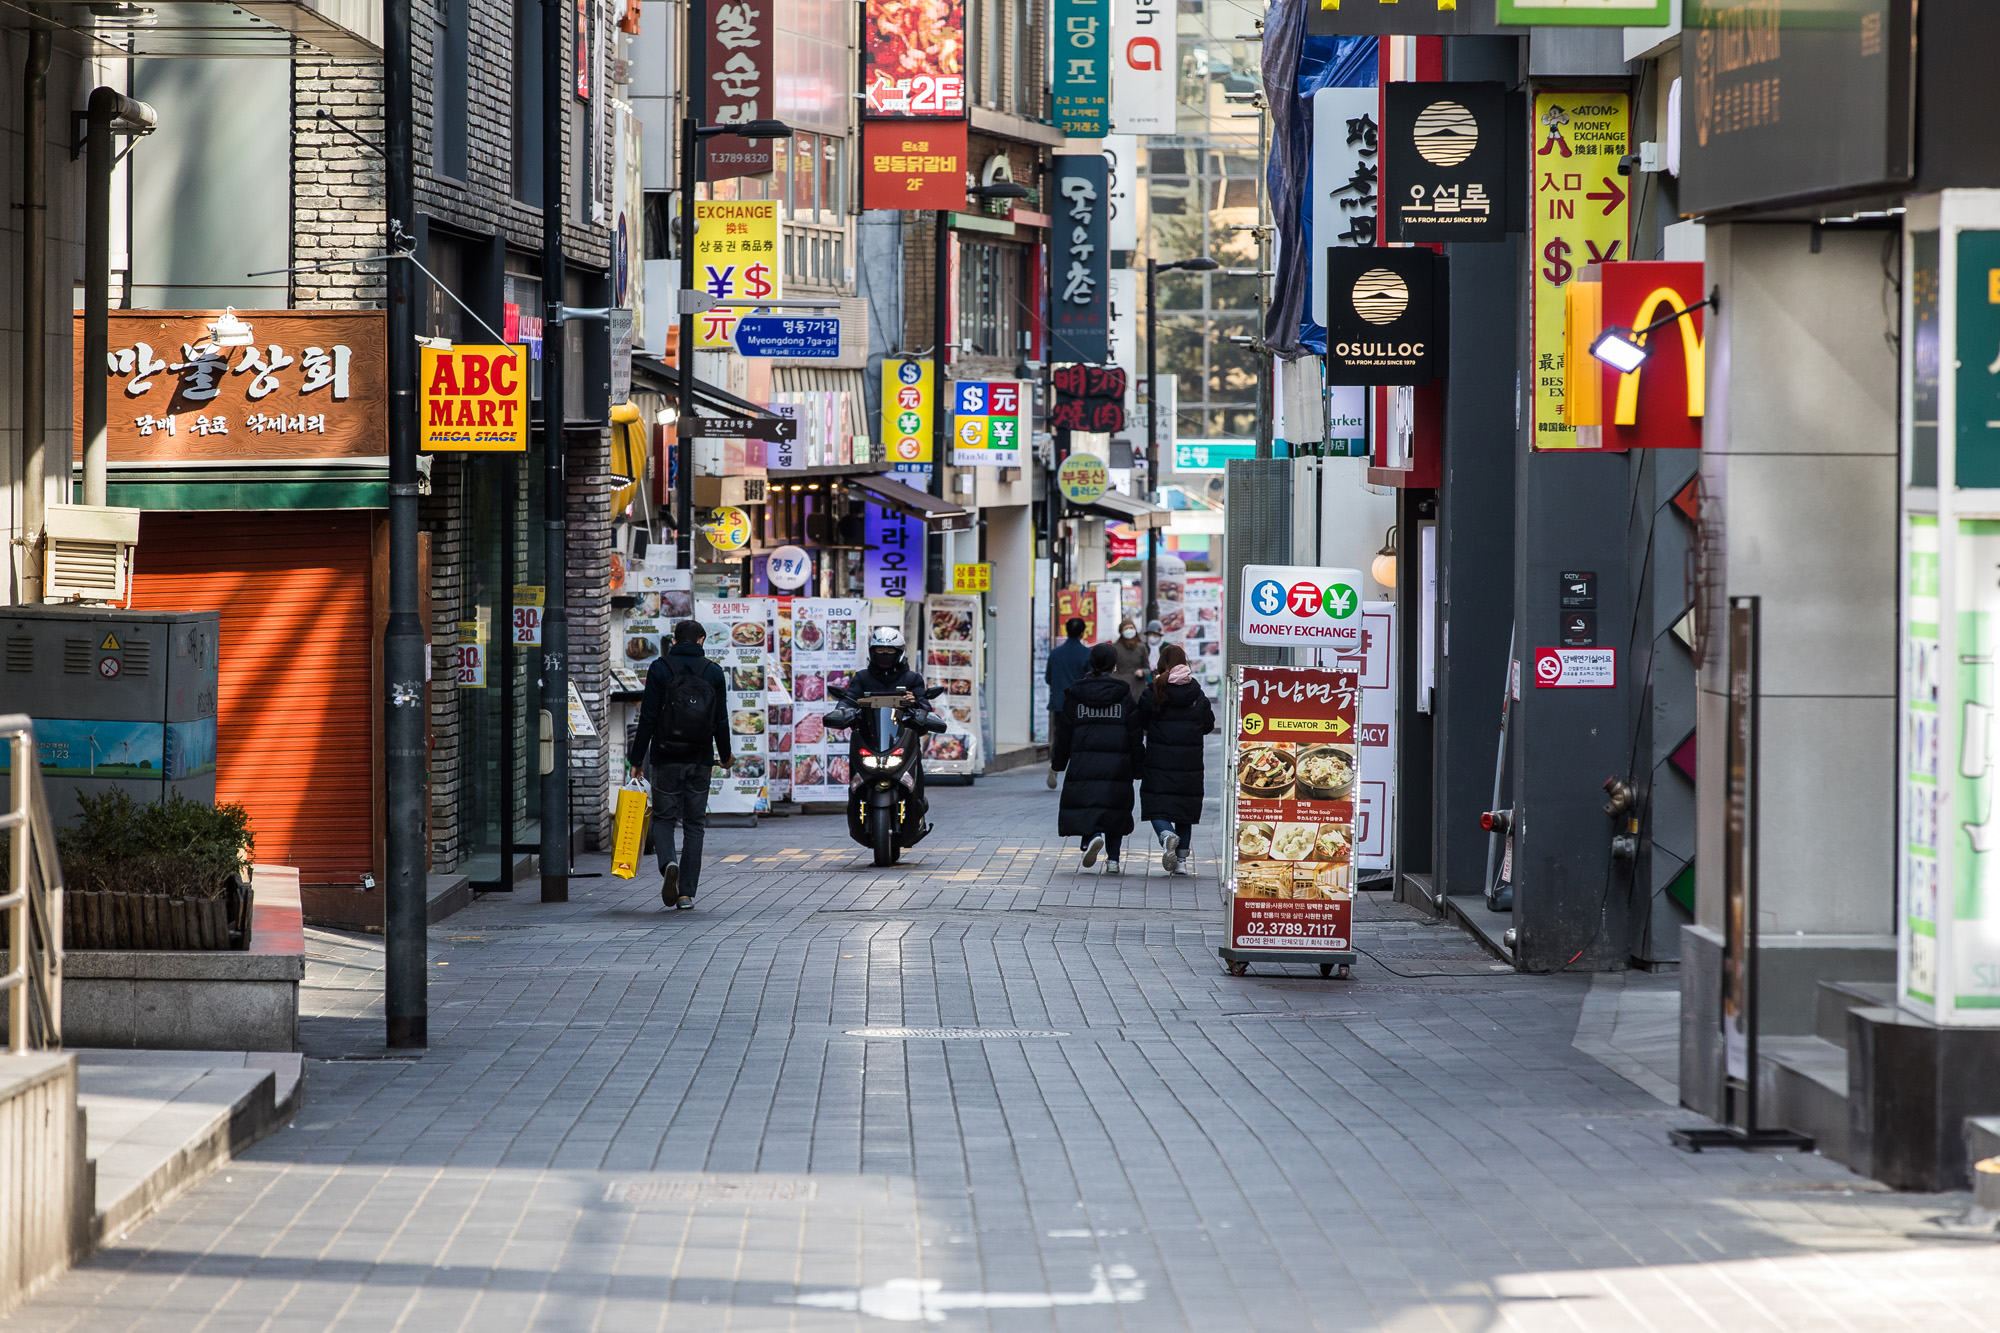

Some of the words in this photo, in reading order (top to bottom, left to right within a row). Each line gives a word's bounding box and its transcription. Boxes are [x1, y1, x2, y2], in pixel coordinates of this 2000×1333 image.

[1066, 0, 1100, 84] 당포
[911, 76, 960, 110] 2F
[1573, 121, 1611, 131] MONEY
[1573, 132, 1626, 141] EXCHANGE
[873, 155, 957, 173] 명동닭갈비
[906, 178, 924, 191] 2F
[1539, 172, 1582, 192] 入口
[1401, 183, 1491, 215] 오설록
[697, 206, 773, 219] EXCHANGE
[1549, 199, 1574, 220] IN
[699, 240, 737, 253] 상품권
[740, 239, 774, 252] 商品券
[1060, 177, 1097, 305] 목우촌
[1542, 236, 1573, 288] $
[704, 265, 737, 299] ¥
[744, 261, 773, 299] $
[782, 320, 838, 335] 명동7가길
[747, 336, 805, 349] Myeongdong
[806, 336, 838, 346] 7ga-gil
[1335, 342, 1425, 357] OSULLOC
[108, 342, 352, 400] 만물상회
[428, 354, 519, 396] ABC
[902, 364, 918, 383] $
[1053, 363, 1125, 397] 明洞
[900, 389, 918, 408] 元
[962, 385, 984, 413] $
[992, 388, 1018, 412] 元
[428, 400, 518, 427] MART
[135, 414, 177, 437] 담배
[190, 415, 229, 437] 우표
[246, 413, 326, 434] 악세서리
[900, 414, 918, 433] ¥
[429, 431, 471, 442] MEGA
[474, 431, 518, 442] STAGE
[960, 421, 982, 445] €
[992, 421, 1015, 446] ¥
[900, 440, 918, 459] €
[1061, 469, 1105, 486] 부동산
[1070, 486, 1101, 497] 플러스
[713, 511, 725, 527] ¥
[729, 510, 742, 527] $
[711, 530, 727, 545] 元
[730, 529, 742, 545] €
[956, 566, 988, 577] 상품권
[1259, 582, 1279, 614] $
[1291, 585, 1318, 613] 元
[1329, 588, 1352, 617] ¥
[712, 603, 750, 614] 점심메뉴
[828, 608, 852, 616] BBQ
[1249, 623, 1293, 636] MONEY
[1294, 625, 1357, 639] EXCHANGE
[1562, 655, 1613, 664] 담배연기싫어요
[1241, 677, 1356, 710] 강남면옥
[1244, 718, 1262, 730] 5F
[1277, 720, 1319, 729] ELEVATOR
[1324, 721, 1338, 730] 3m
[51, 749, 69, 759] 123
[1247, 921, 1337, 936] 02.3789.7117
[1241, 937, 1261, 945] 170석
[1262, 937, 1276, 945] 완비
